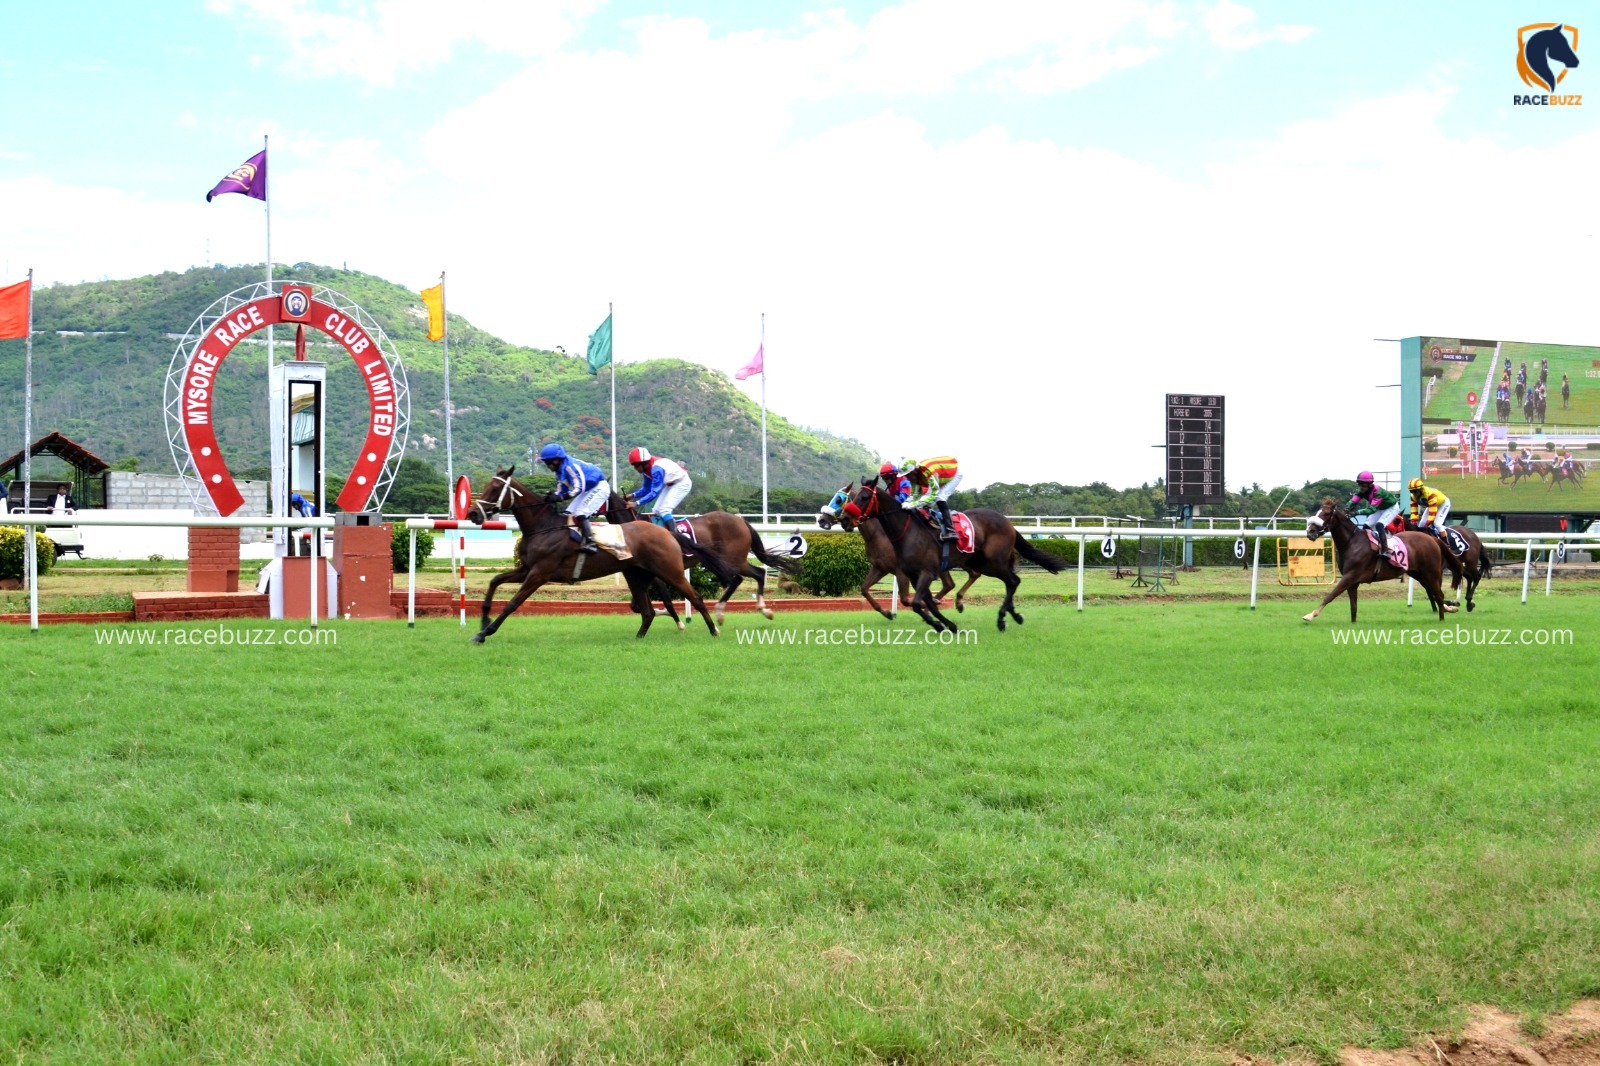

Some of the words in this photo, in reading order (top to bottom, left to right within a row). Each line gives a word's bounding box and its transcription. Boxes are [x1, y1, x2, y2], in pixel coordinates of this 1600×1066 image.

[187, 349, 219, 425] MYSORE
[214, 305, 265, 346] RACE
[325, 313, 370, 355] CLUB
[364, 359, 393, 436] LIMITED
[789, 535, 804, 556] 2
[1103, 538, 1113, 556] 4
[1236, 540, 1244, 557] 5
[1455, 537, 1466, 551] 5
[1558, 542, 1565, 557] 8
[1391, 550, 1407, 567] 12
